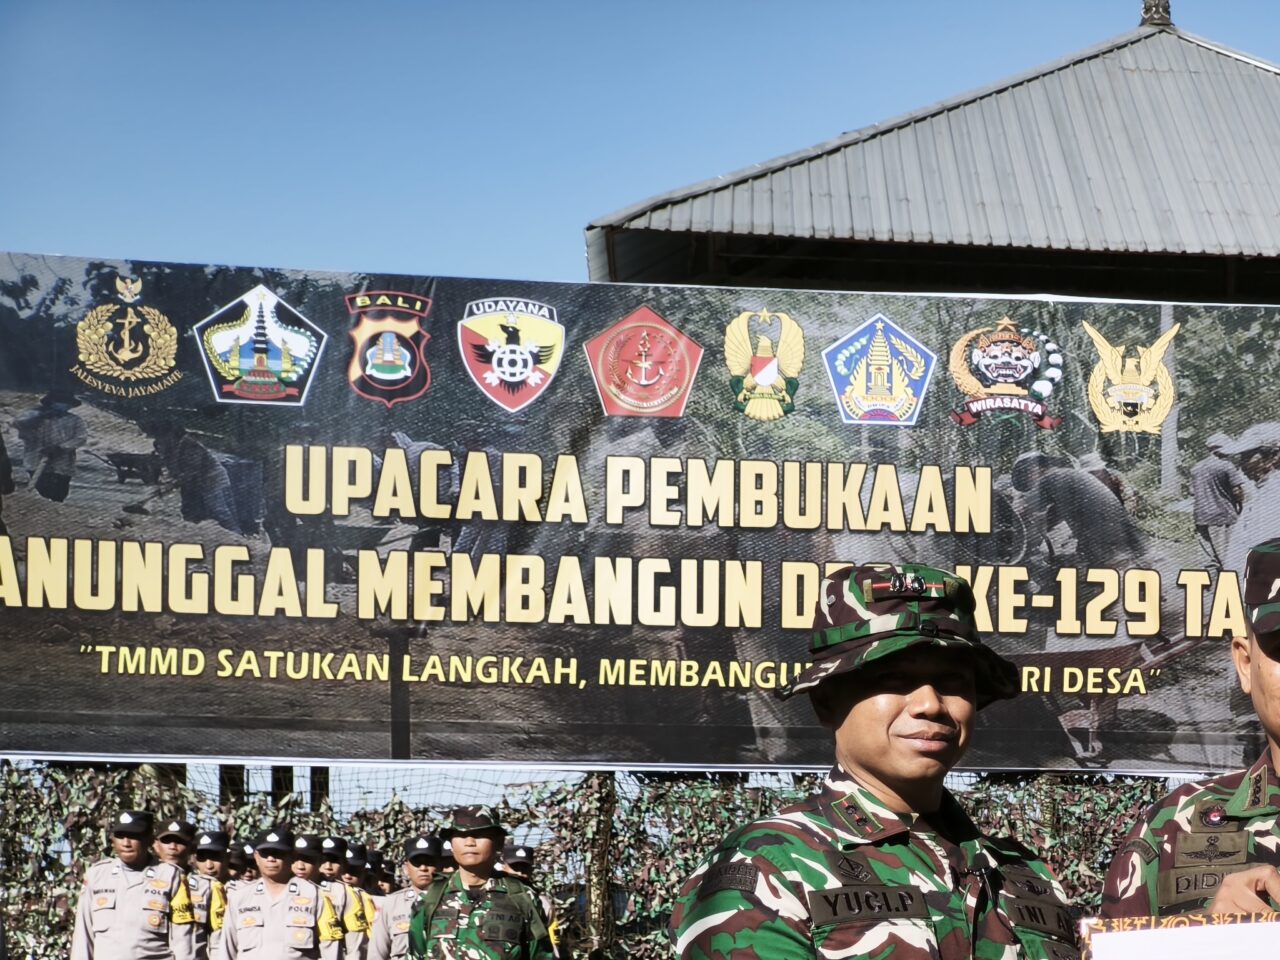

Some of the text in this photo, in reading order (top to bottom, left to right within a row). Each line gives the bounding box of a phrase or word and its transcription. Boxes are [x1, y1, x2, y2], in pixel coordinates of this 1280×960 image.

[356, 295, 423, 310] BALI
[472, 302, 549, 319] UDAYANA
[69, 365, 183, 398] JALESVEVA JAYAMAHE
[970, 396, 1043, 415] WIRASATYA
[285, 445, 992, 534] UPACARA PEMBUKAAN
[0, 535, 338, 618] ANUNGGAL
[357, 550, 762, 628] MEMBANGUN
[955, 565, 1160, 636] KE-129
[217, 648, 389, 681] SATUKAN
[402, 654, 586, 688] LANGKAH,
[599, 659, 813, 690] MEMBANGU
[1021, 666, 1051, 692] RI
[1014, 904, 1047, 926] TNI
